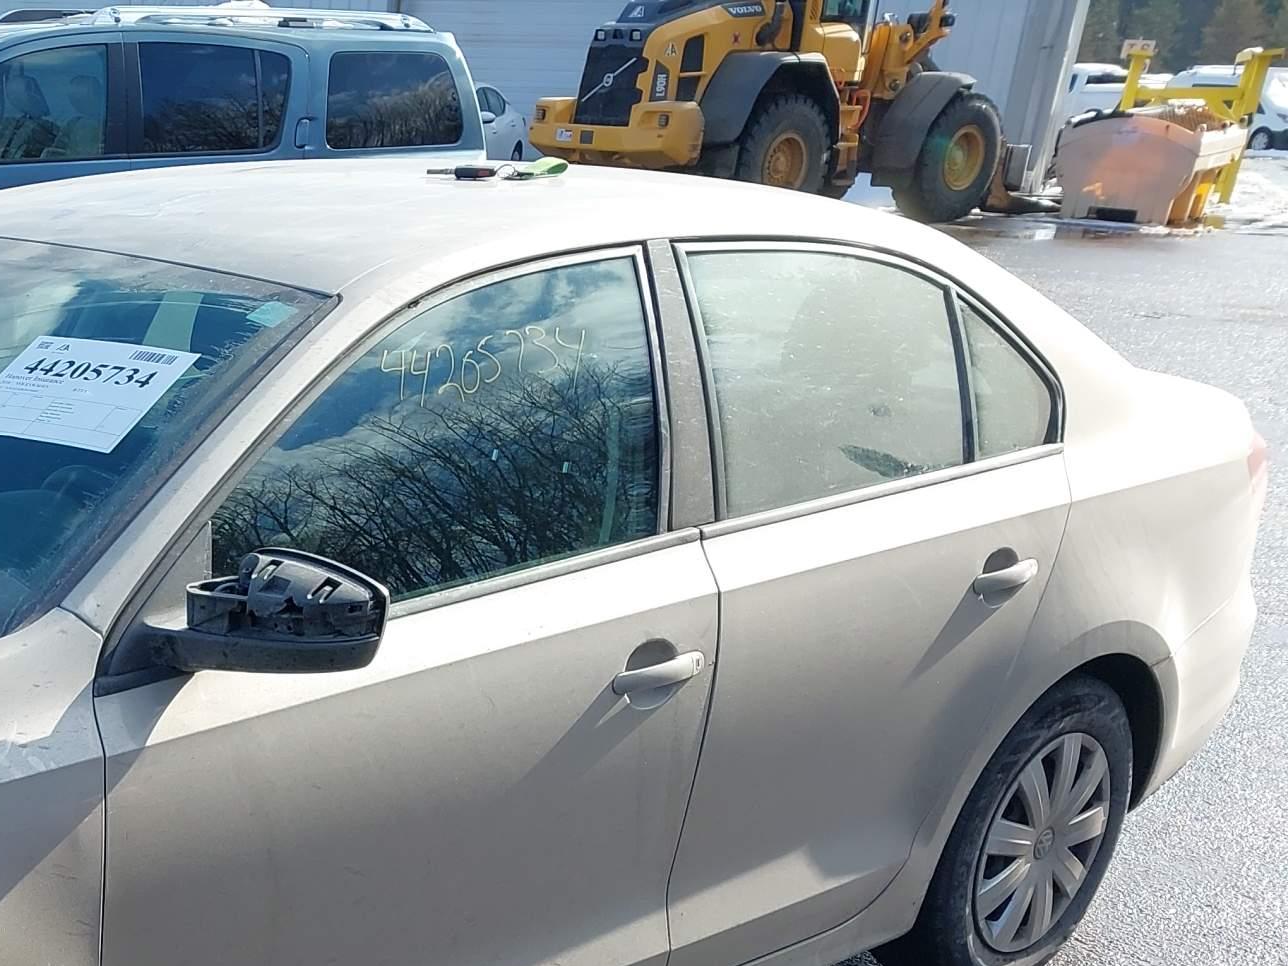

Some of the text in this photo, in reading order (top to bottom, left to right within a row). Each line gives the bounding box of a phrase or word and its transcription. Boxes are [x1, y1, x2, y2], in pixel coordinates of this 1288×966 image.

[728, 5, 762, 14] VOLVO
[24, 357, 158, 388] 44205734
[380, 325, 586, 407] 44205734
